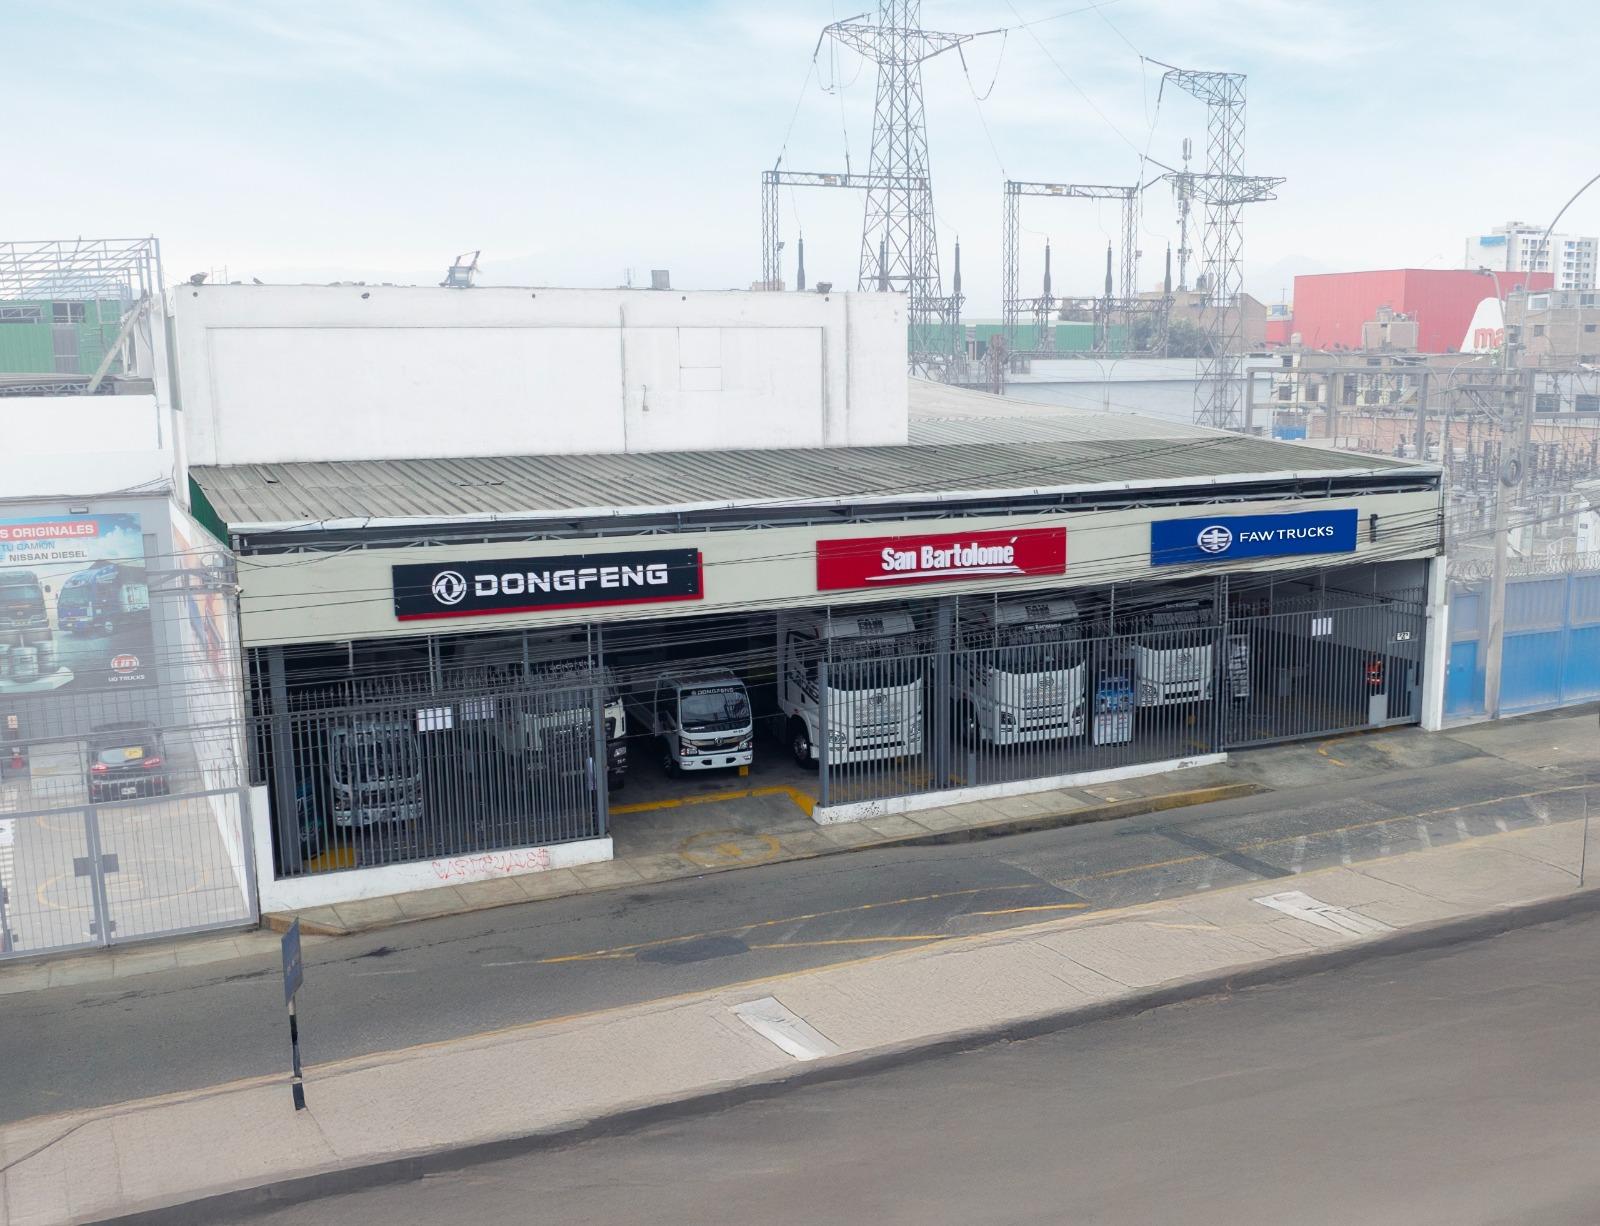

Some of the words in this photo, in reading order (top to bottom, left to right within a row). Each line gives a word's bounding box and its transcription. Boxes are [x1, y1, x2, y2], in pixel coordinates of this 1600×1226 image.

[12, 524, 94, 538] ORIGINALES
[1239, 530, 1274, 543] FAW
[1276, 525, 1335, 541] TRUCKS
[1, 544, 14, 552] TU
[16, 541, 55, 551] CAMIÓN
[881, 547, 918, 572] San
[921, 535, 1017, 568] Bartolomé
[9, 553, 49, 562] NISSAN
[51, 550, 87, 560] DIESEL
[474, 563, 669, 597] DONGFENG
